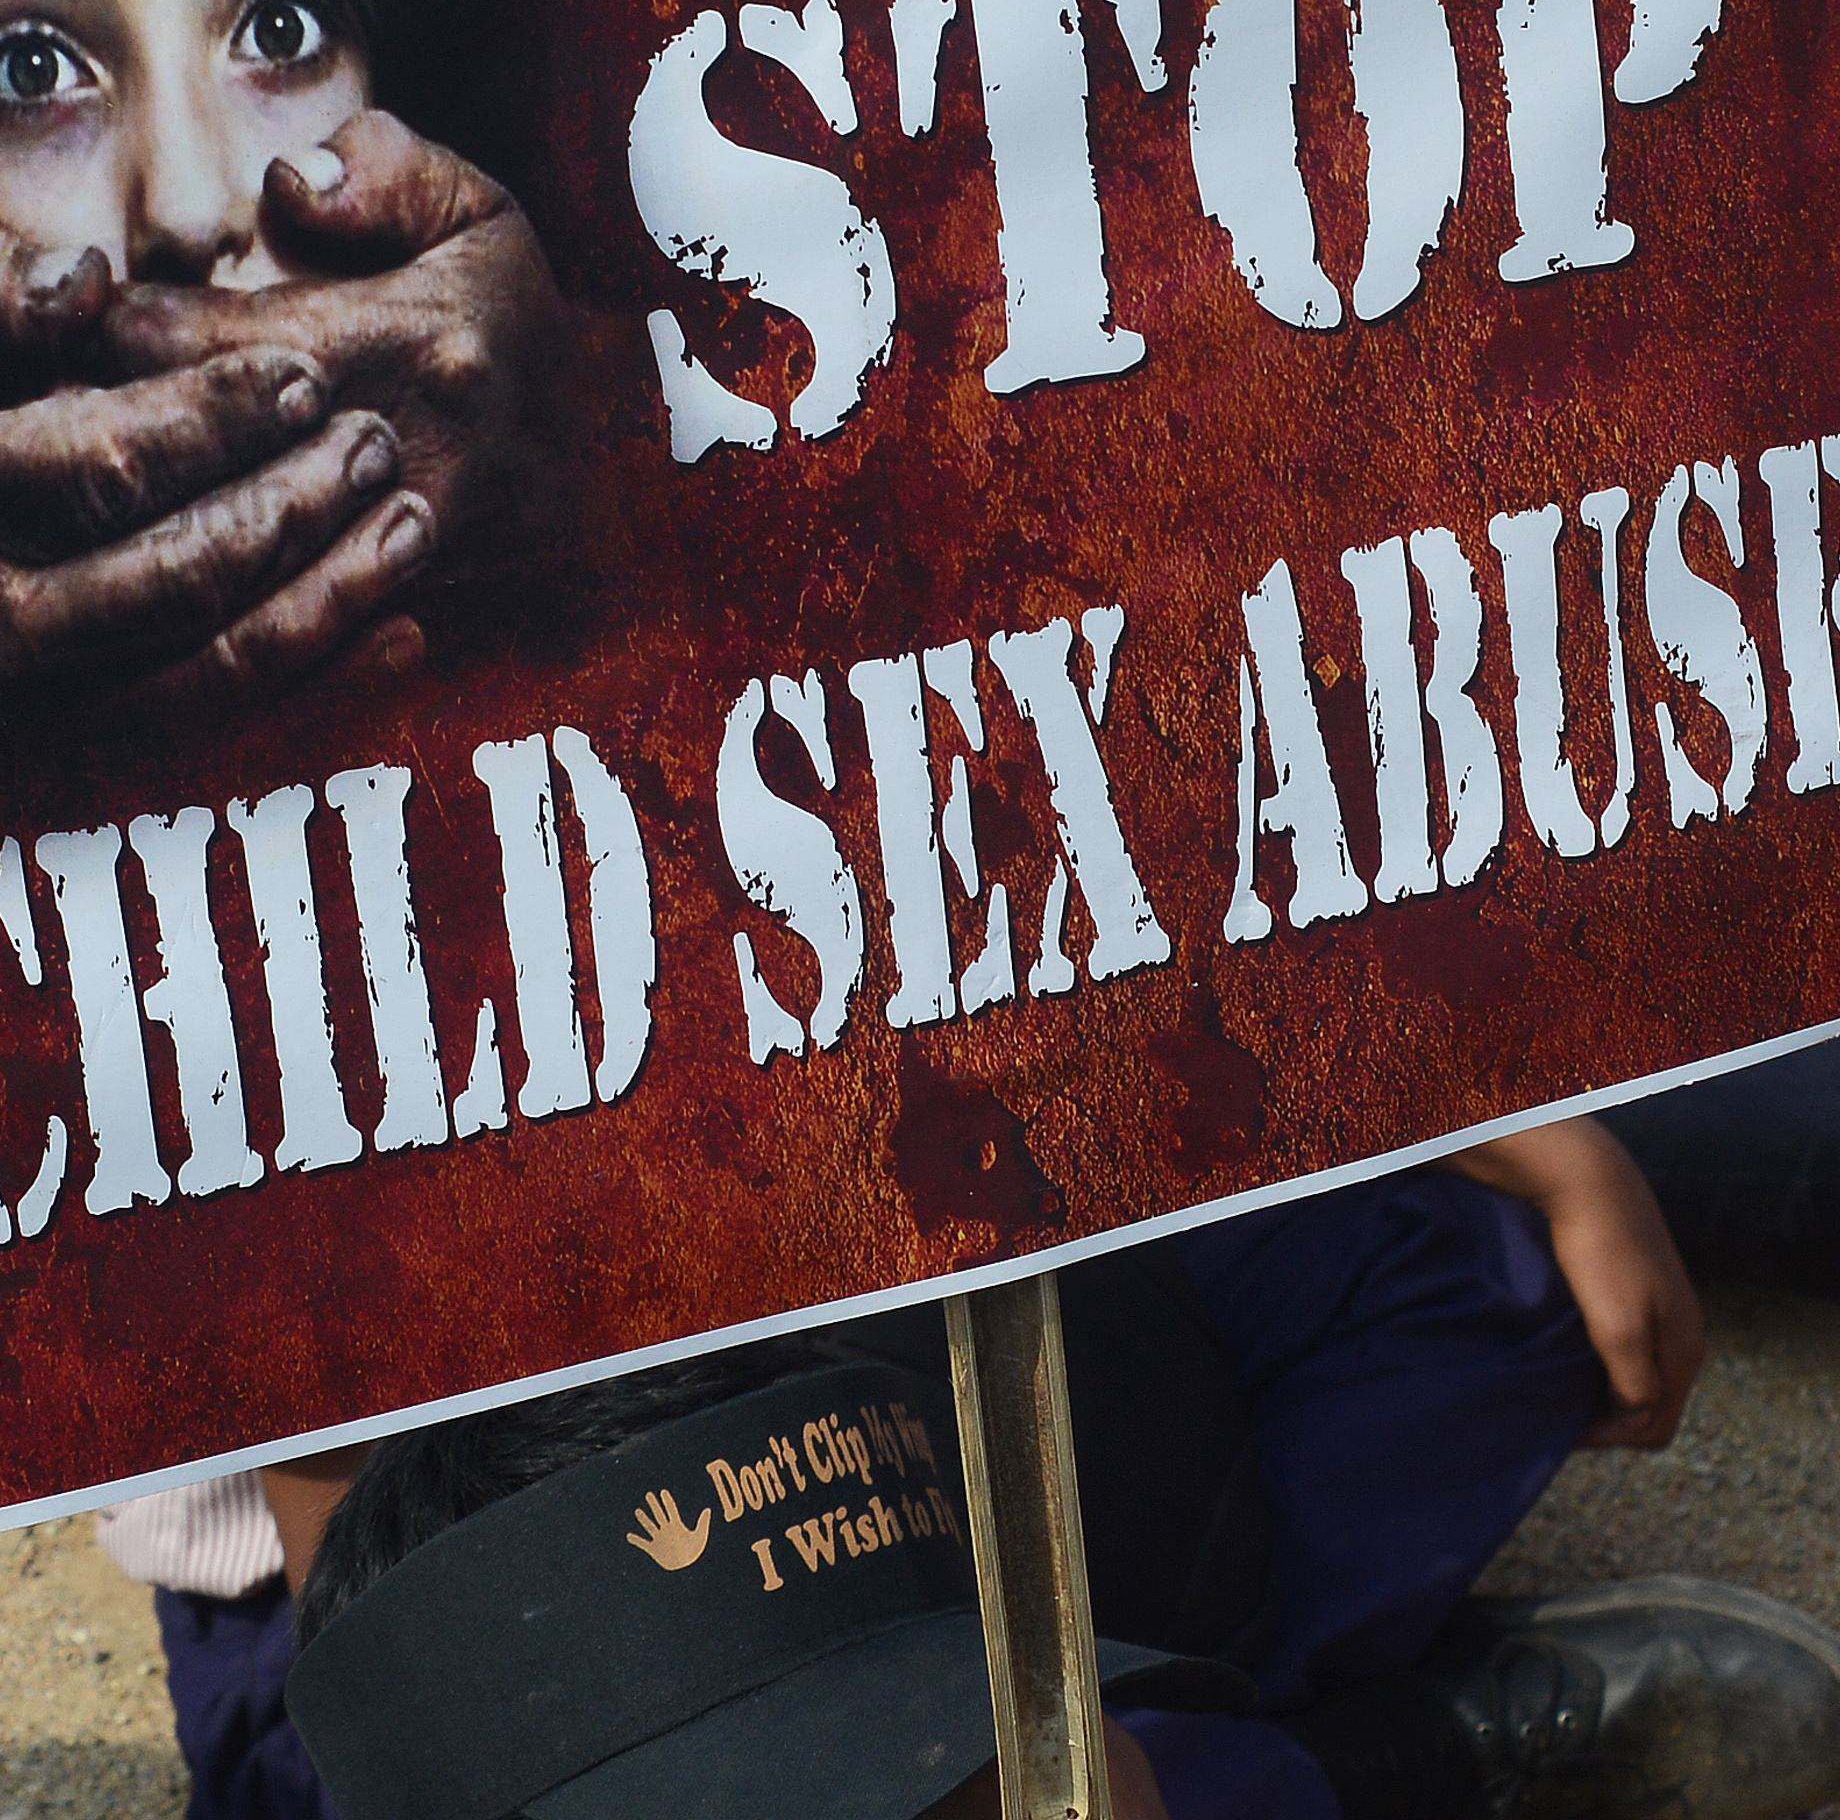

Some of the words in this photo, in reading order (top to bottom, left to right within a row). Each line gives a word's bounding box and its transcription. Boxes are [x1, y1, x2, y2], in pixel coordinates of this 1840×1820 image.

[715, 604, 1171, 1065] SEX
[705, 1435, 807, 1523] Don't
[801, 1412, 873, 1486] Clip
[751, 1538, 785, 1592] I
[784, 1496, 904, 1573] Wish
